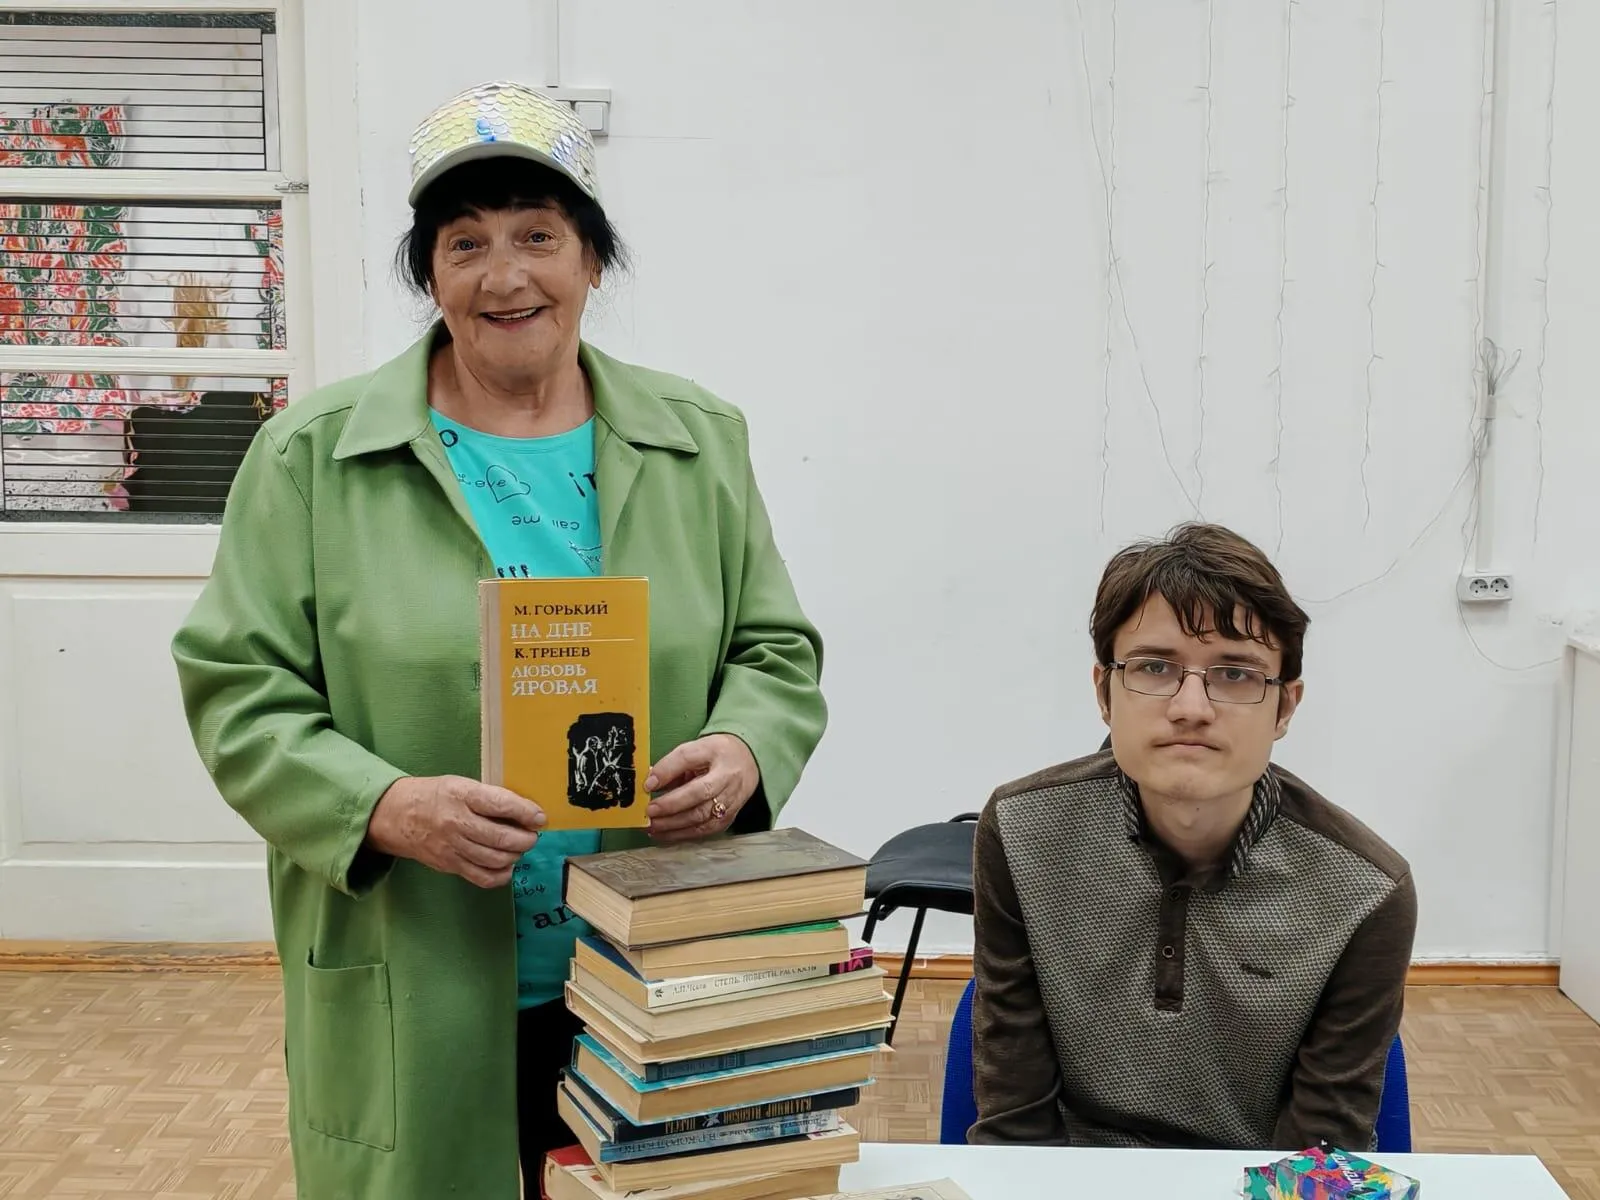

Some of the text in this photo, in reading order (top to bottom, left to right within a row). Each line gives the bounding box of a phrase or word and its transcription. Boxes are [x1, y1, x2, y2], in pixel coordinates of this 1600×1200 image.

[511, 514, 541, 526] me
[511, 621, 592, 639] НА ДНЕ
[511, 663, 587, 678] ЛЮБОВЬ
[512, 678, 598, 696] ЯРОВАЯ
